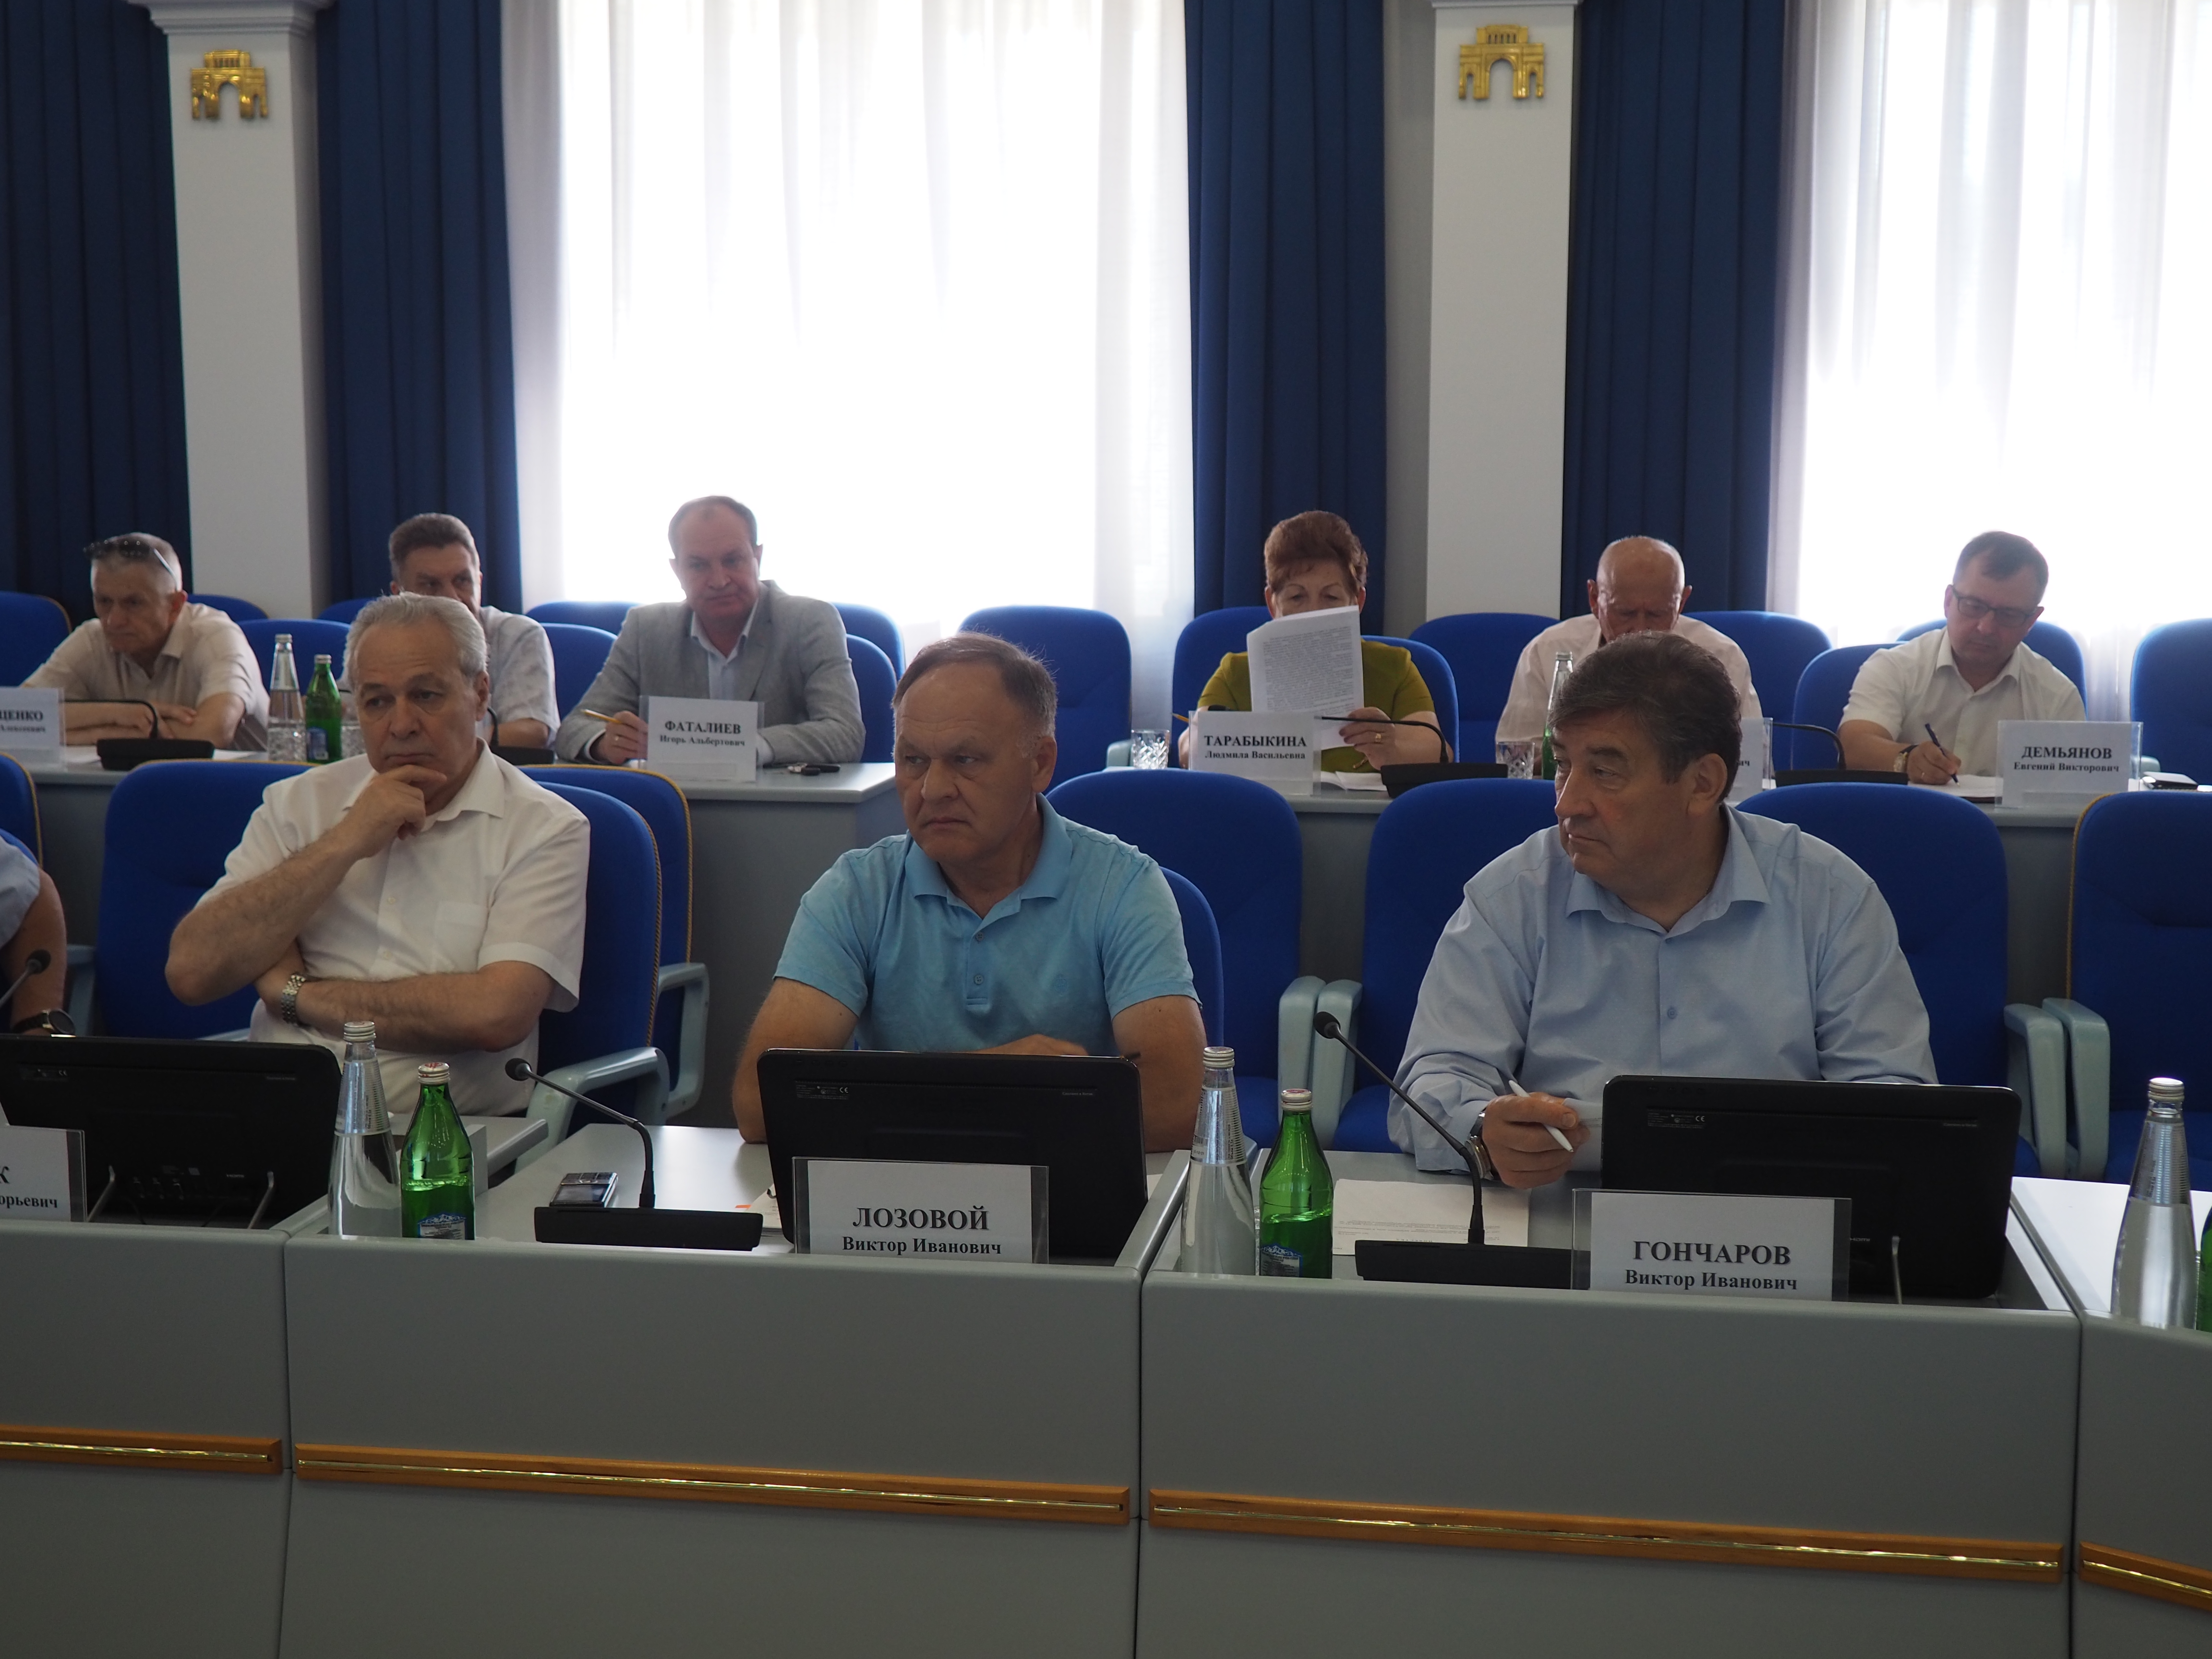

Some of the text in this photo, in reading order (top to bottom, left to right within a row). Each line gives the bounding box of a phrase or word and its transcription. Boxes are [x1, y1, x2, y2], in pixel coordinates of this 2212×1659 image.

[664, 721, 741, 734] ФАТАЛИЕВ
[660, 734, 745, 746] Игорь Альбертович
[1204, 735, 1307, 747] ТАРАБЫКИНА
[1205, 751, 1306, 759] Людмила Васильевна
[2021, 746, 2113, 759] ДЕМЬЯНОВ
[2013, 761, 2119, 773] Евгений Викторович
[0, 1195, 58, 1209] орьевич
[852, 1205, 989, 1231] ЛОЗОВОЙ
[842, 1236, 1002, 1255] Виктор Иванович
[1632, 1240, 1791, 1266] ГОНЧАРОВ
[1624, 1269, 1798, 1290] Виктор Иванович
